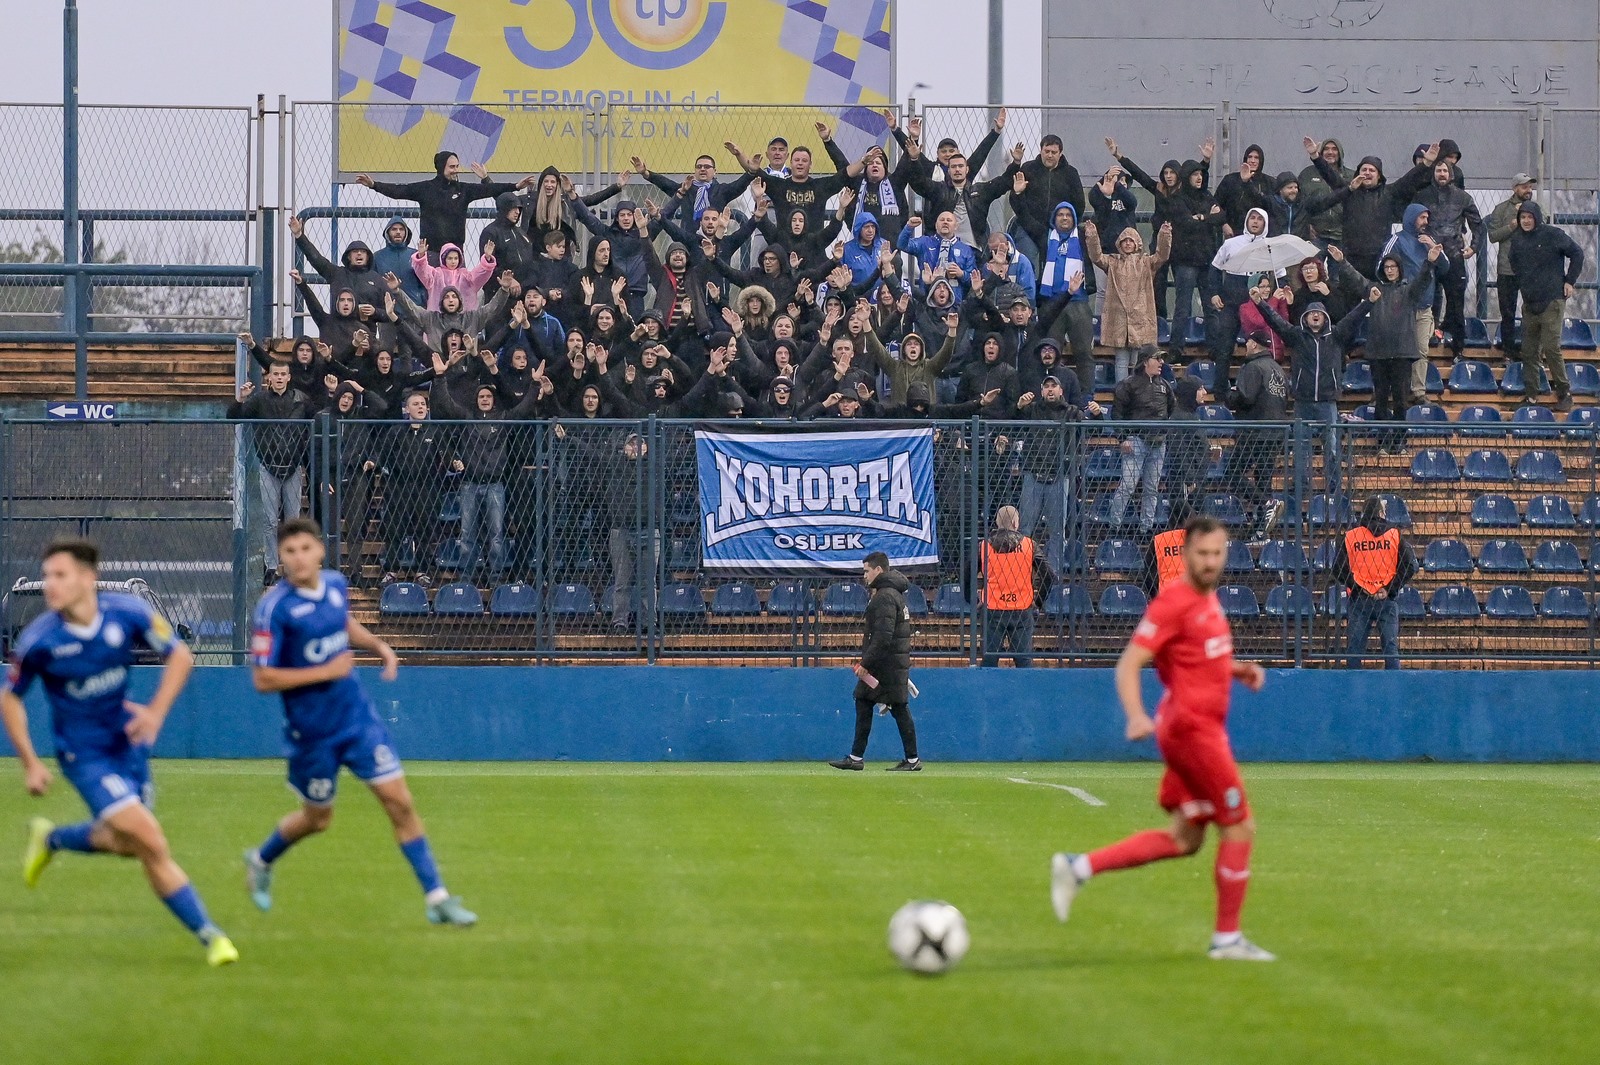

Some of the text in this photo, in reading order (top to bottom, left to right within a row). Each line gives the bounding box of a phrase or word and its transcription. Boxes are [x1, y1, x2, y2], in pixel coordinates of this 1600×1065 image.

[503, 90, 671, 112] TERMOPLIN
[541, 117, 690, 138] VARAŽDIN
[83, 404, 114, 419] WC
[714, 450, 918, 527] KOHORTA
[773, 532, 864, 551] OSIJEK
[1354, 540, 1391, 552] REDAR
[1000, 593, 1017, 602] 428
